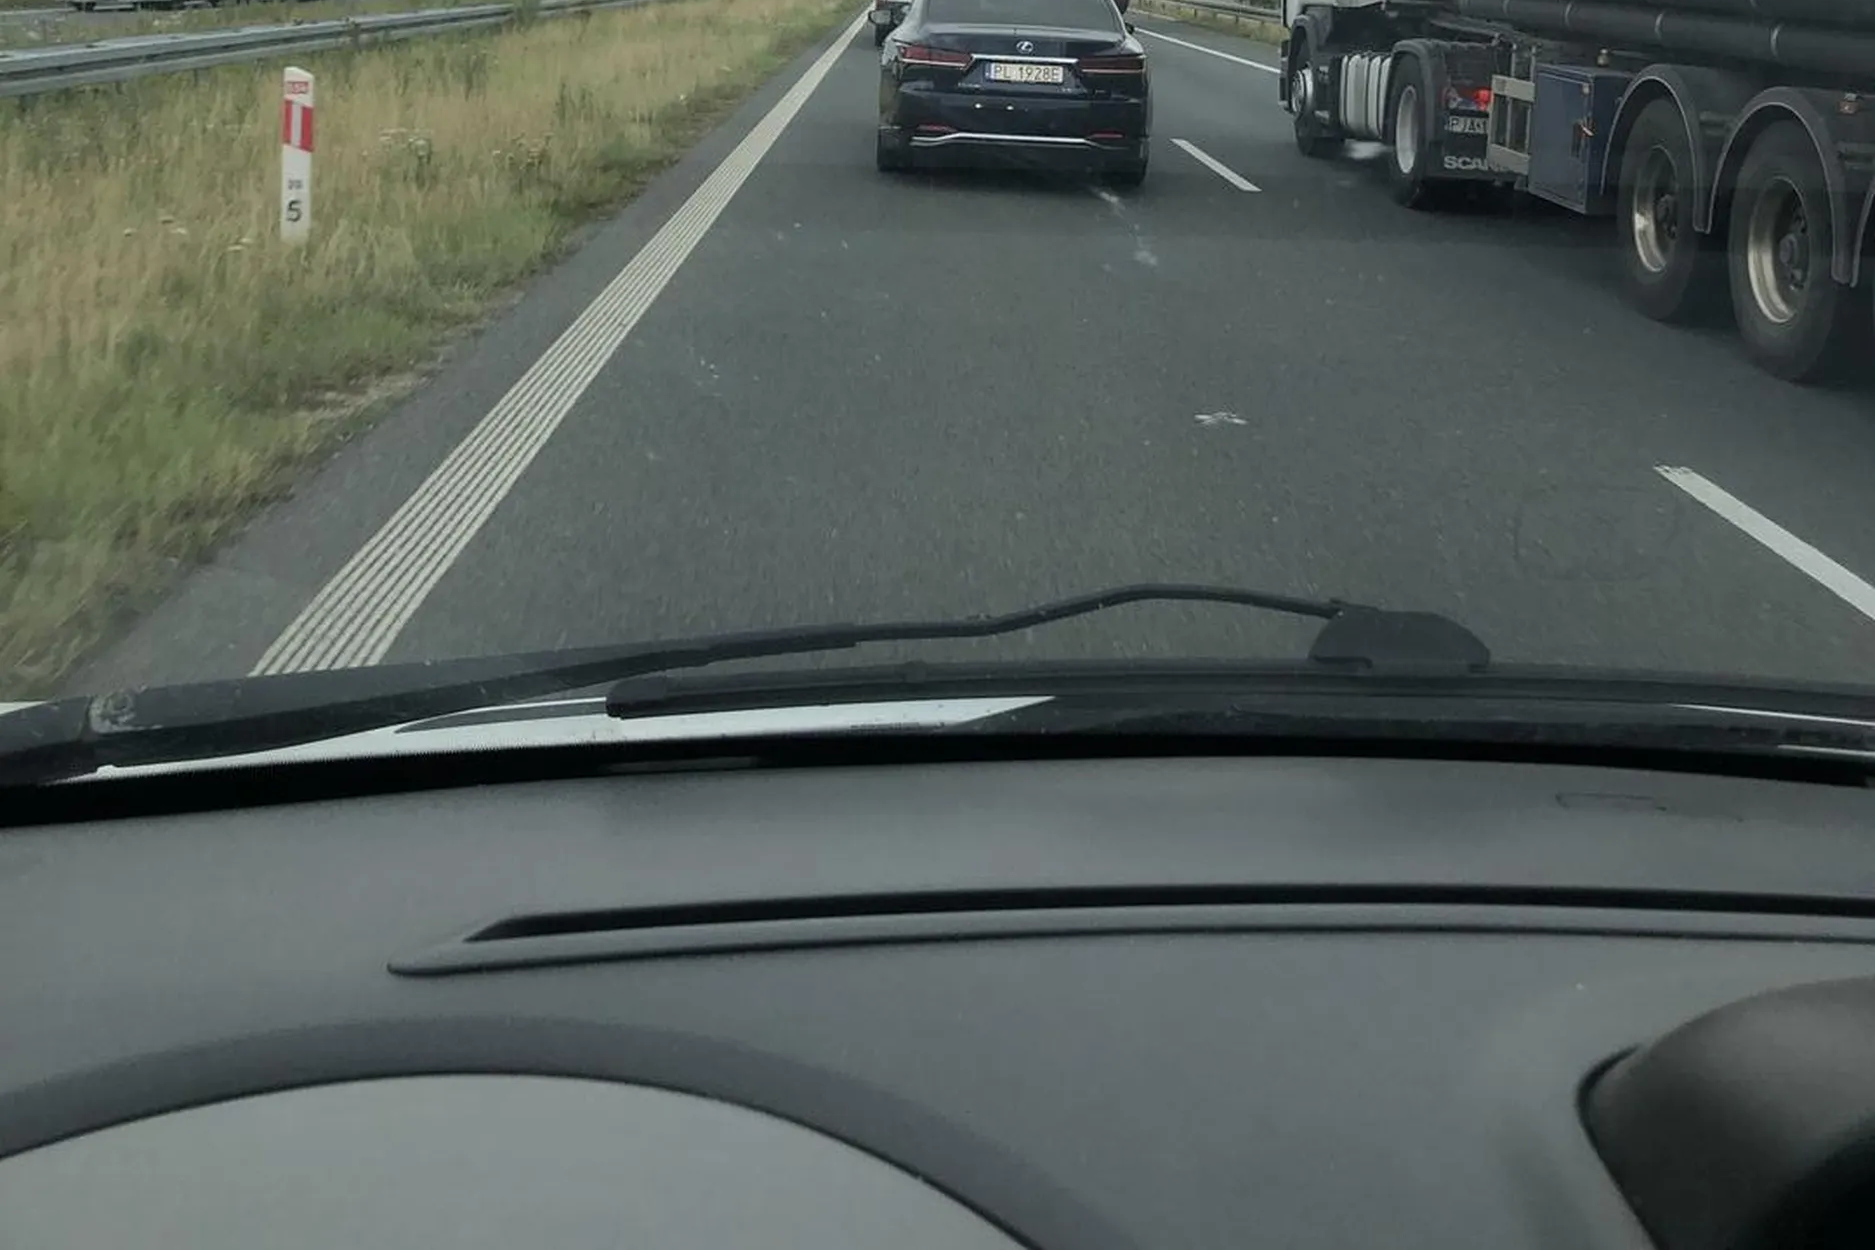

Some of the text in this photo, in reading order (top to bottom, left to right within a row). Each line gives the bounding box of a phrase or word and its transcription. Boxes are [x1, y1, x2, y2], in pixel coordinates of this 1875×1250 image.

[994, 64, 1060, 82] PL 1928E
[287, 200, 303, 222] 5
